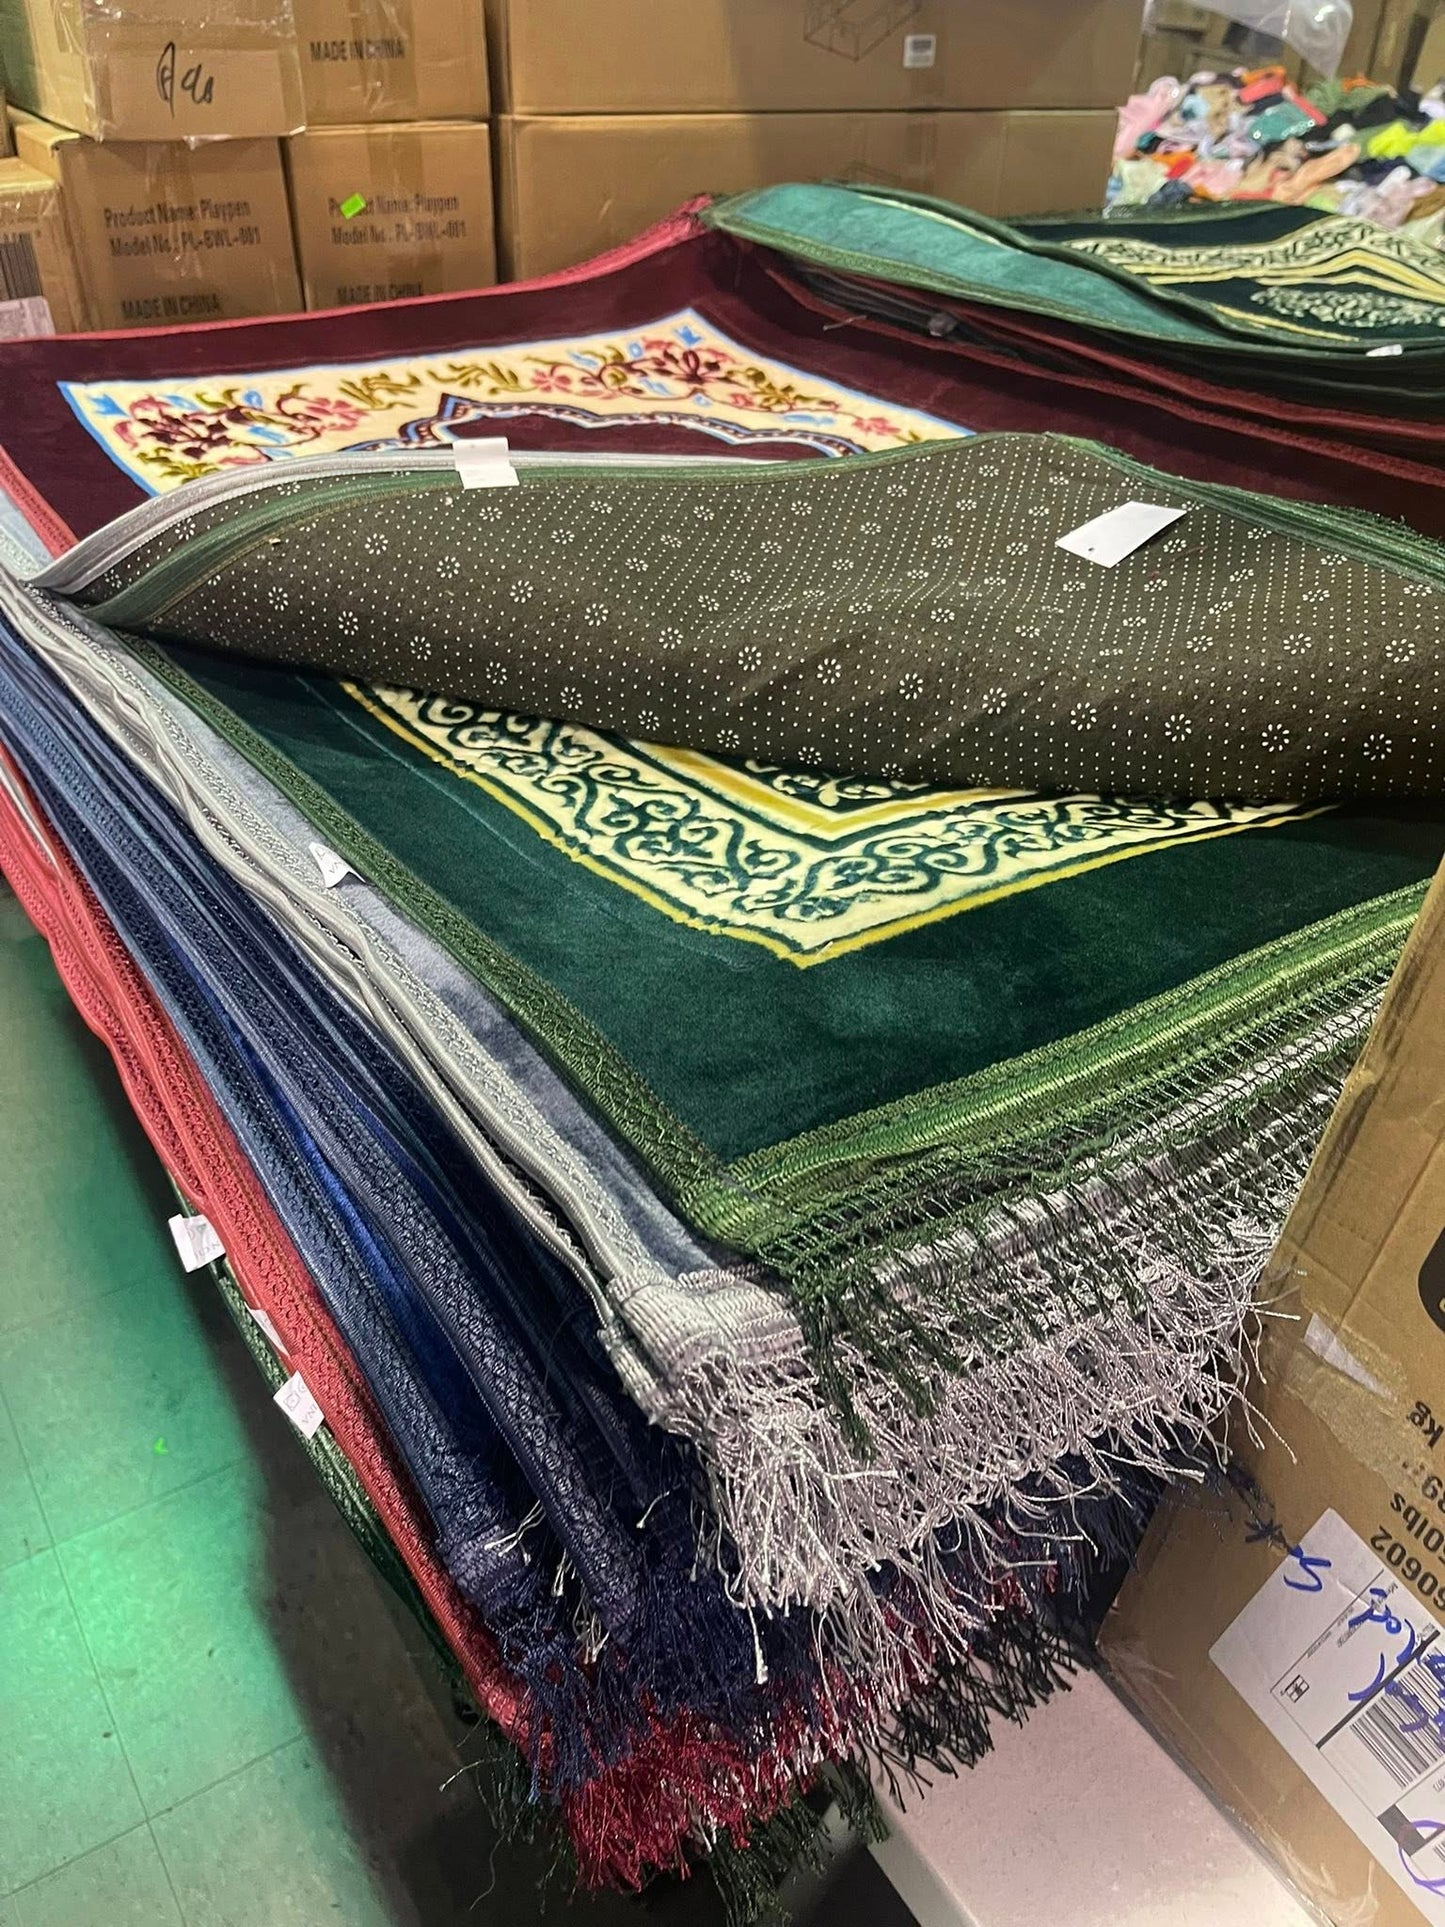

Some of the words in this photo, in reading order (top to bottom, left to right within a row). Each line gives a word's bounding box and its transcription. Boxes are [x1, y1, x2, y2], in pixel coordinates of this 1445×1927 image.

[309, 40, 347, 61] MADE
[349, 39, 364, 60] IN
[104, 204, 155, 229] Product
